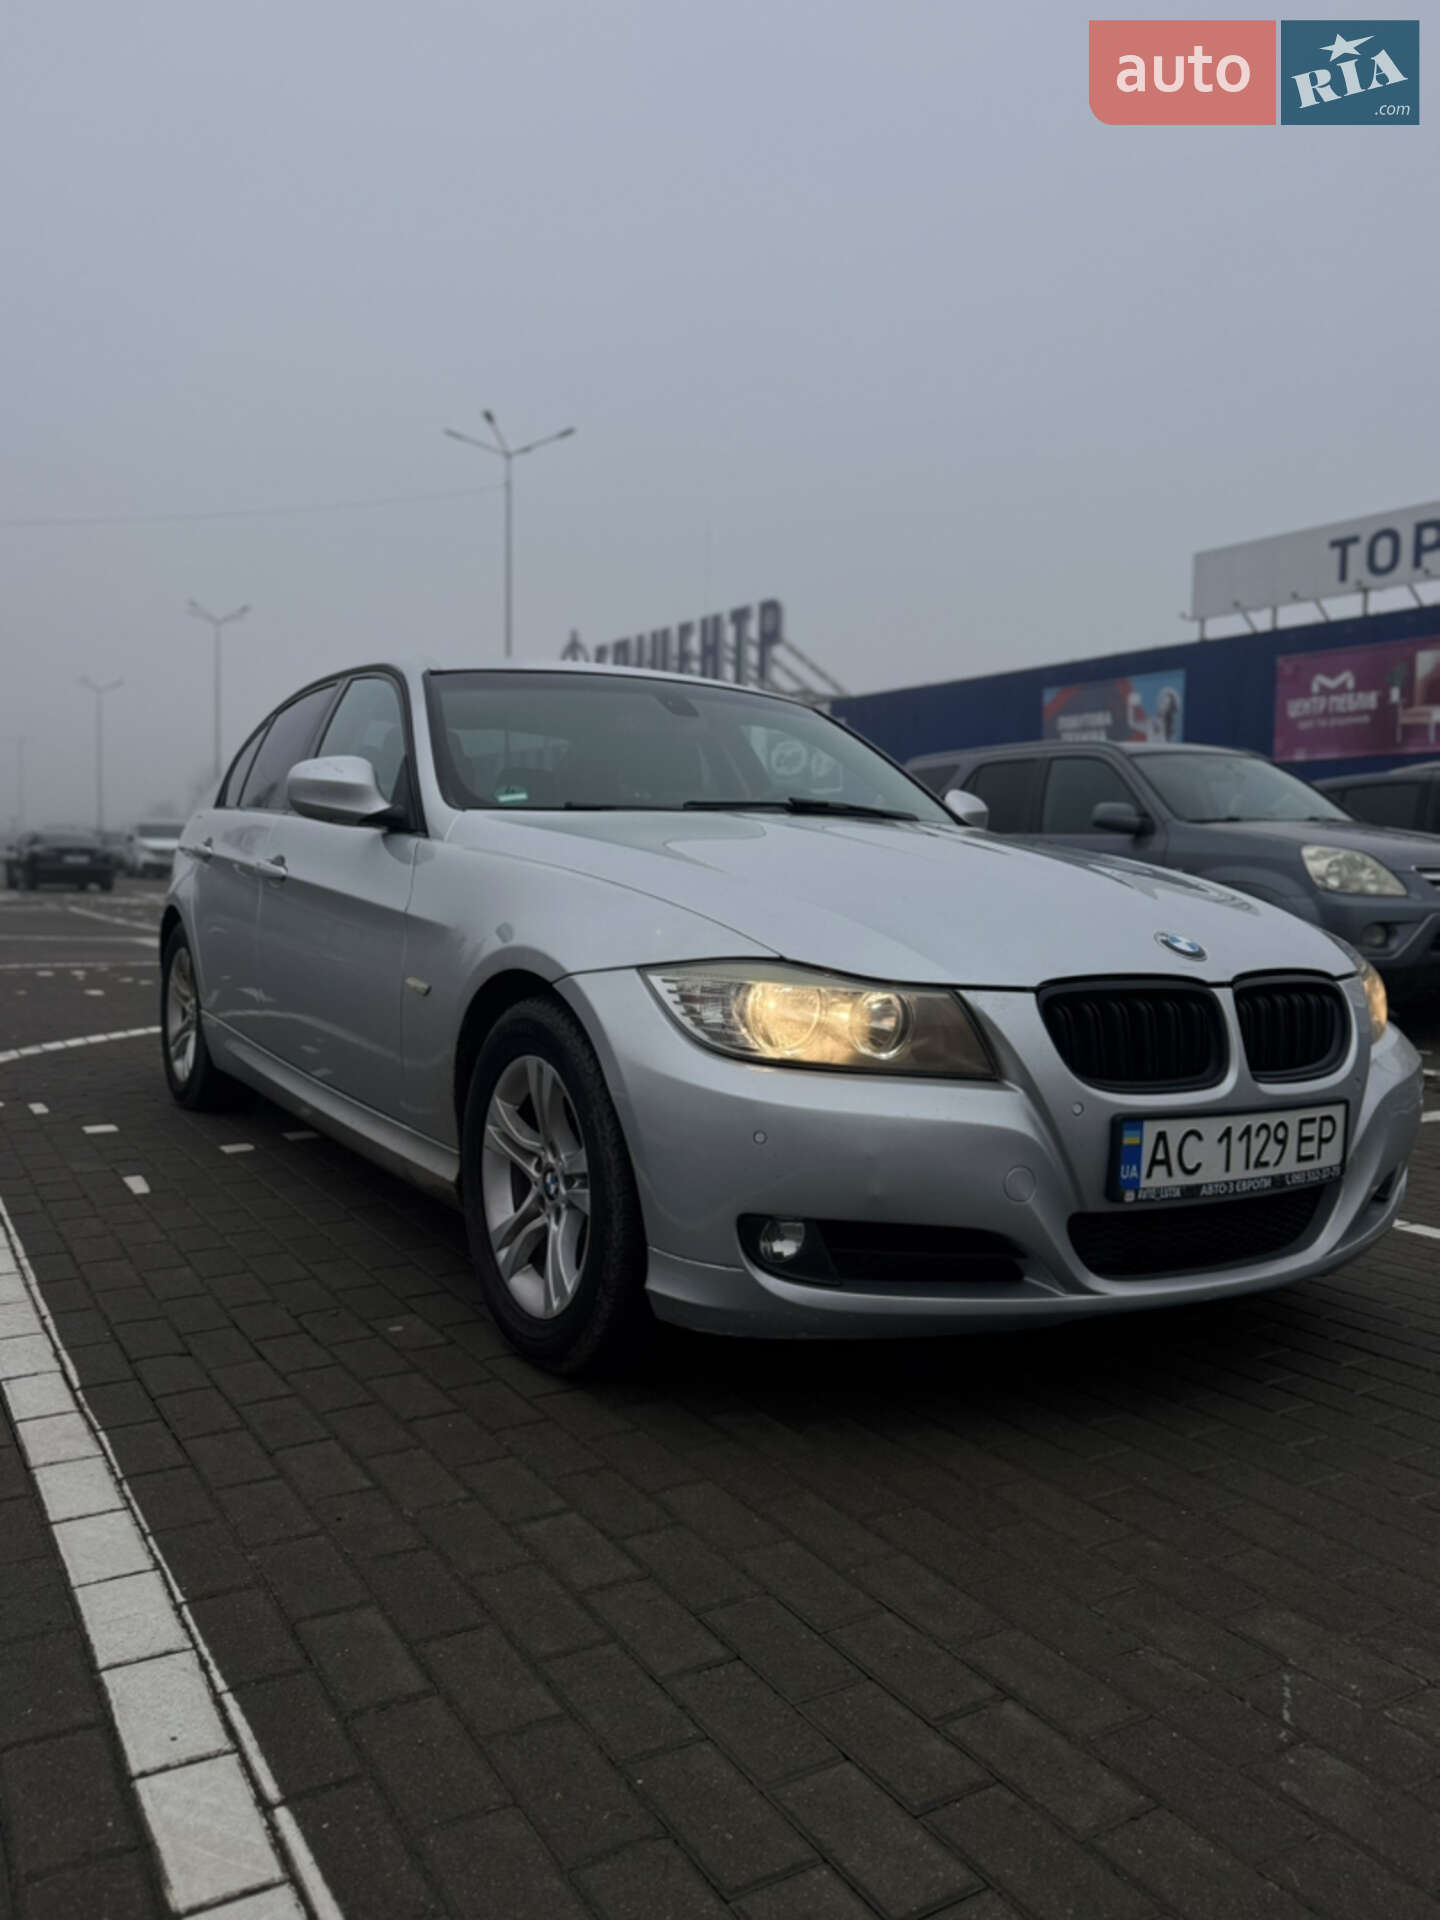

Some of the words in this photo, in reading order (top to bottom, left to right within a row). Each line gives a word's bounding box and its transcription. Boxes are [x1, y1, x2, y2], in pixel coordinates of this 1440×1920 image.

[1146, 1129, 1204, 1179] AC
[1217, 1120, 1289, 1173] 1129
[1297, 1115, 1337, 1163] EP
[1120, 1164, 1138, 1179] UA
